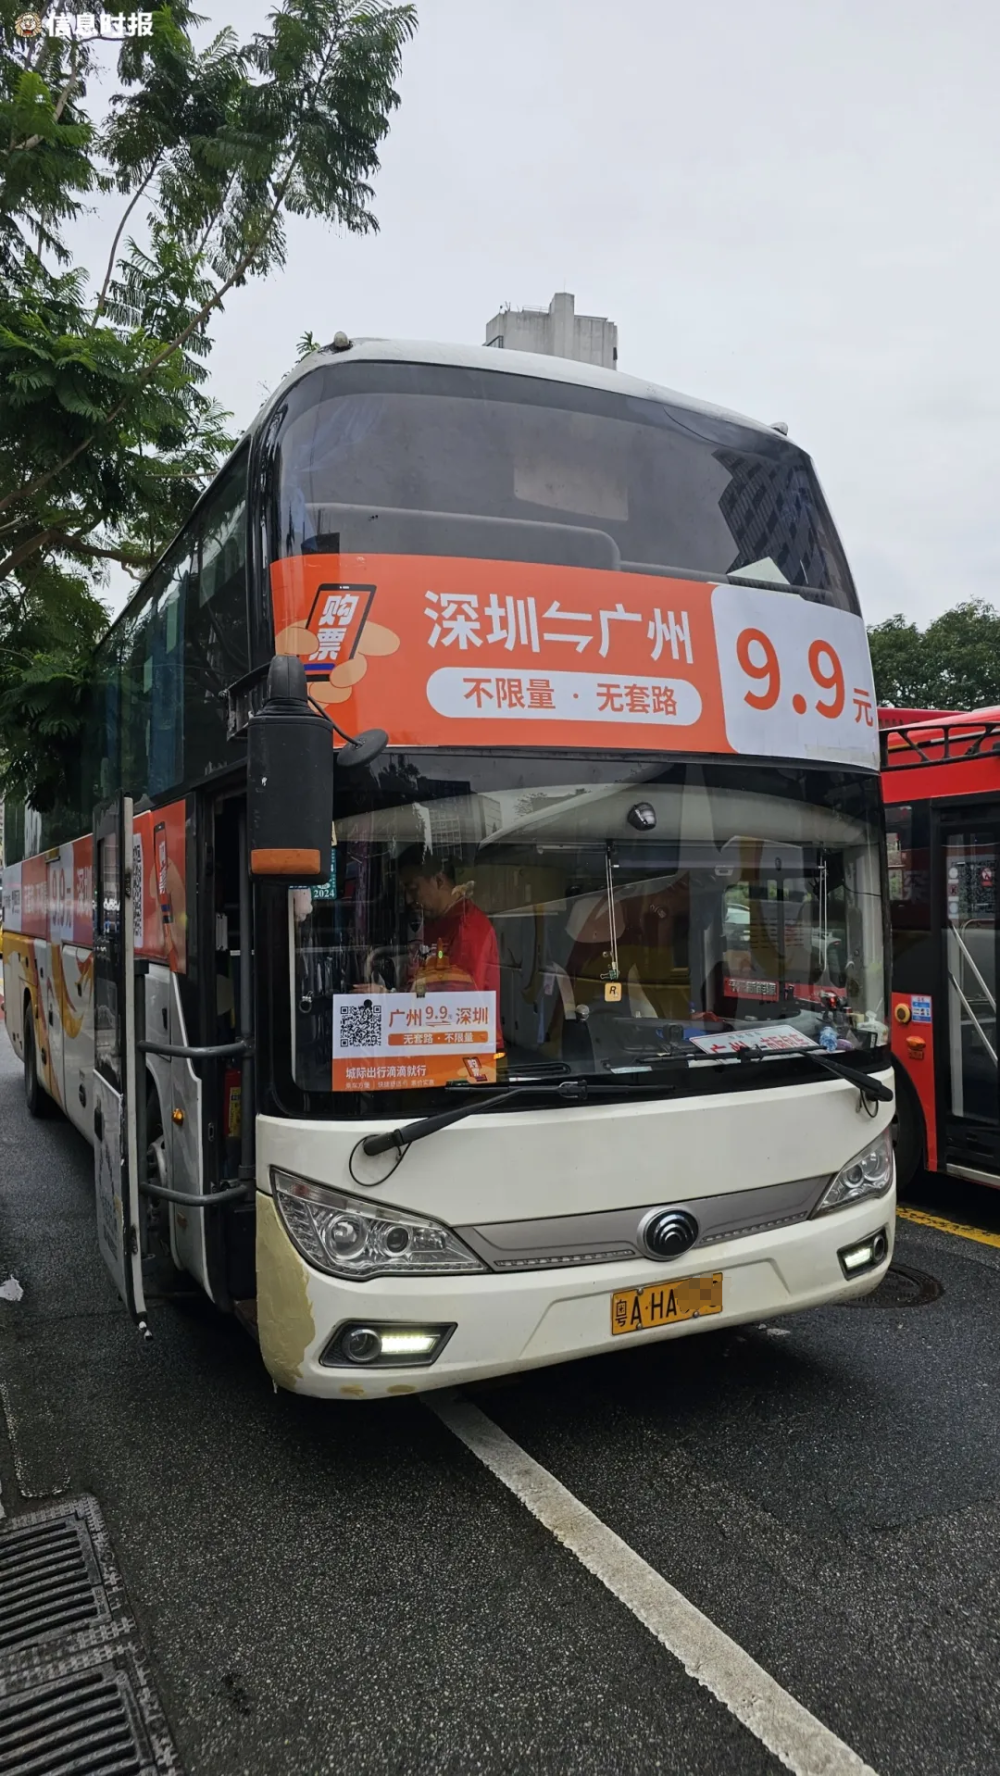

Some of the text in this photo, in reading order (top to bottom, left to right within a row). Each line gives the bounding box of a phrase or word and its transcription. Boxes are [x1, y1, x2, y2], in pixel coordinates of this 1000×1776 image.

[308, 593, 360, 661] 购票
[424, 590, 694, 664] 深圳 广州
[736, 627, 874, 727] 9.9元
[313, 888, 335, 898] 2024
[389, 1009, 422, 1027] 广州
[456, 1007, 488, 1025] 深圳
[345, 1065, 427, 1079] 城际出行滴滴就行
